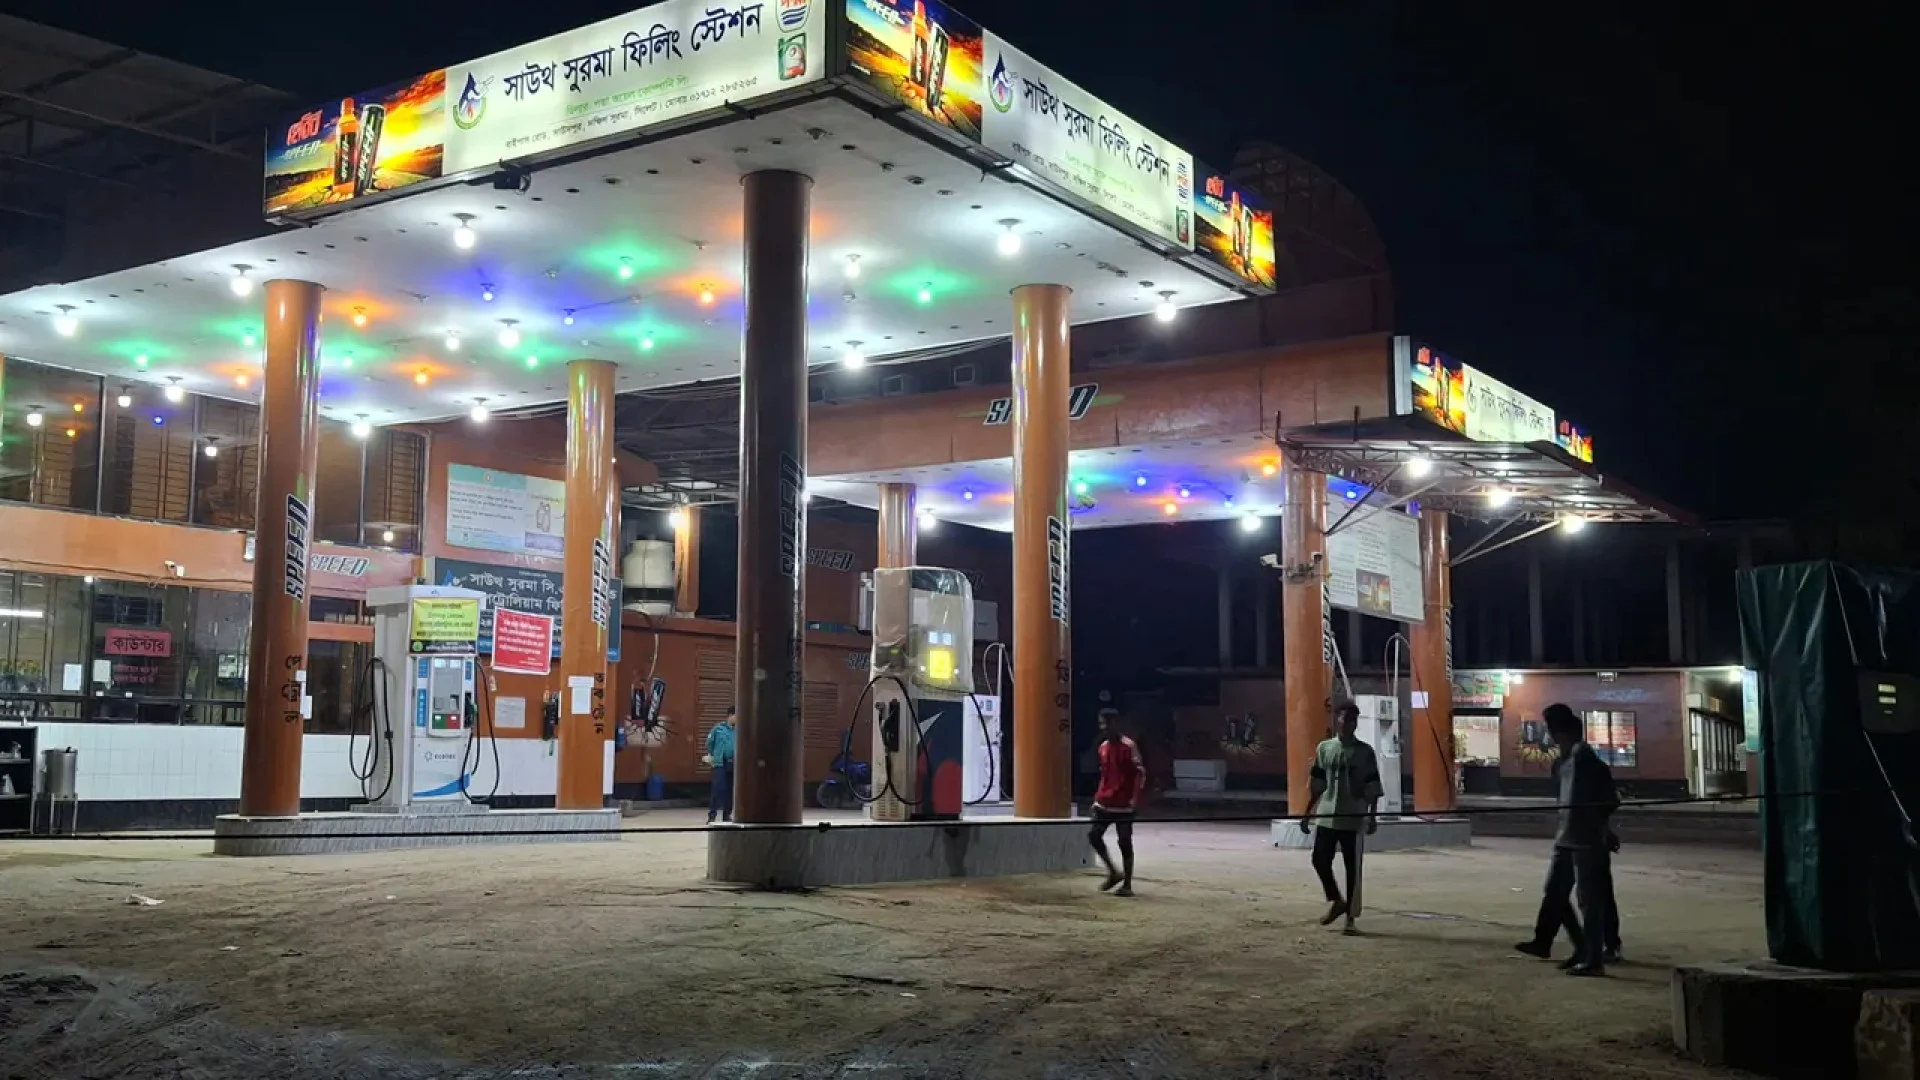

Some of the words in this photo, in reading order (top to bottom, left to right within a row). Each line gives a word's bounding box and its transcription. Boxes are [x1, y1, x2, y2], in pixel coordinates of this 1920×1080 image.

[504, 62, 557, 101] সাউথ
[563, 46, 615, 93] সুরমা
[621, 23, 682, 72] ফিলিং
[691, 3, 763, 51] স্টেশন
[1023, 77, 1059, 123] সাউথ
[1062, 102, 1095, 143] সুরমা
[1098, 115, 1133, 168] ফিলিং
[1135, 140, 1171, 186] স্টেশন
[983, 383, 1099, 426] SPD
[285, 494, 310, 604] SPEED
[311, 553, 369, 576] SPEED
[469, 572, 504, 588] সাউথ
[507, 577, 538, 593] সুরমা
[112, 633, 164, 652] কাউন্টার
